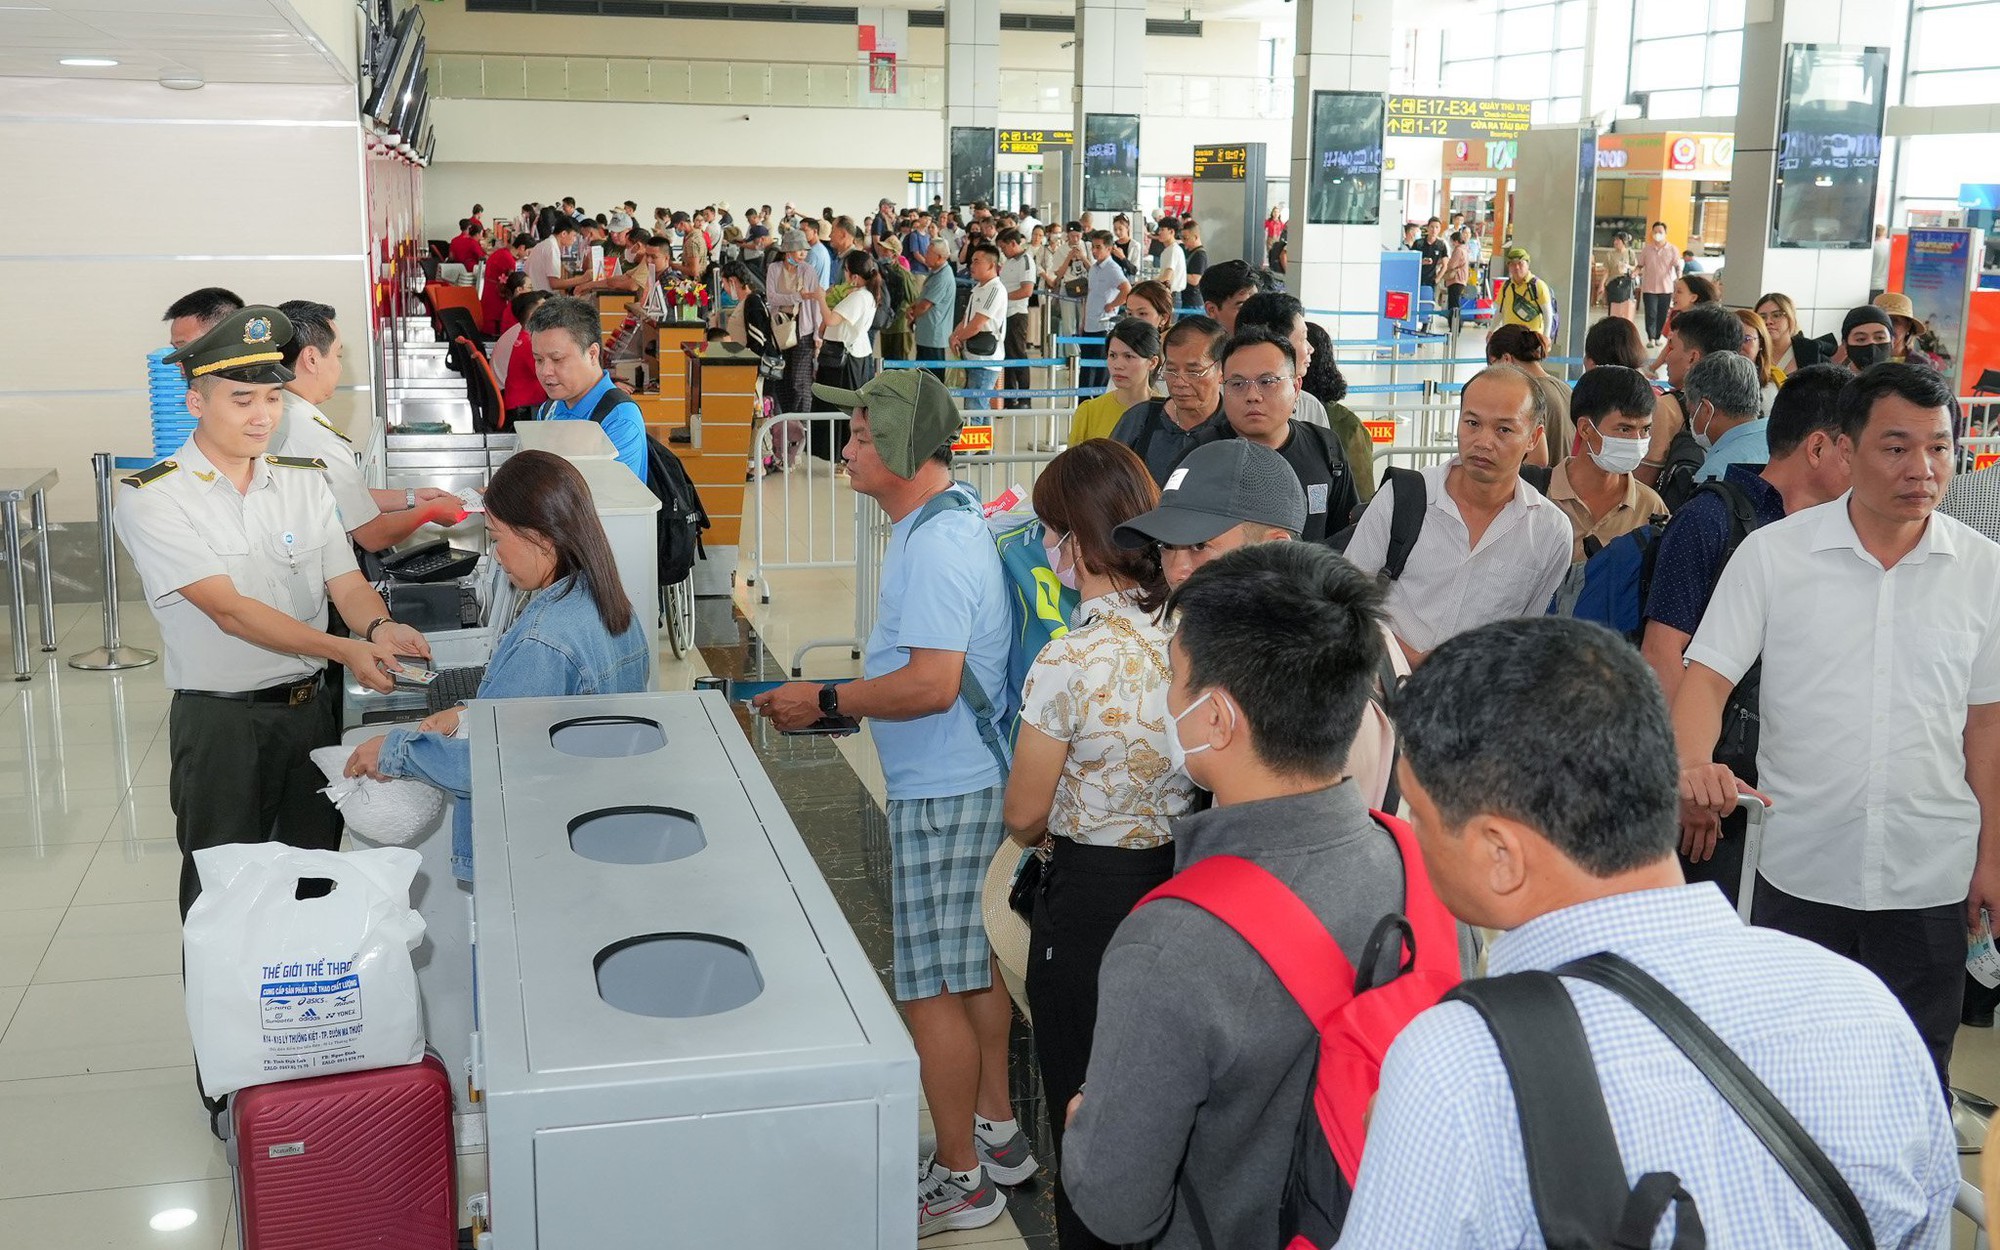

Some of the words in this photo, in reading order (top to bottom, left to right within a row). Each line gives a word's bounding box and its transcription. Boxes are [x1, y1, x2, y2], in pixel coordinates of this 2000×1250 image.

[1416, 99, 1477, 115] E17-E34
[1416, 120, 1448, 135] 1-12
[1022, 132, 1043, 141] 1-12
[262, 962, 282, 979] THẾ
[283, 962, 302, 978] GIỚI
[306, 958, 324, 977] THỂ
[327, 961, 352, 975] THAO
